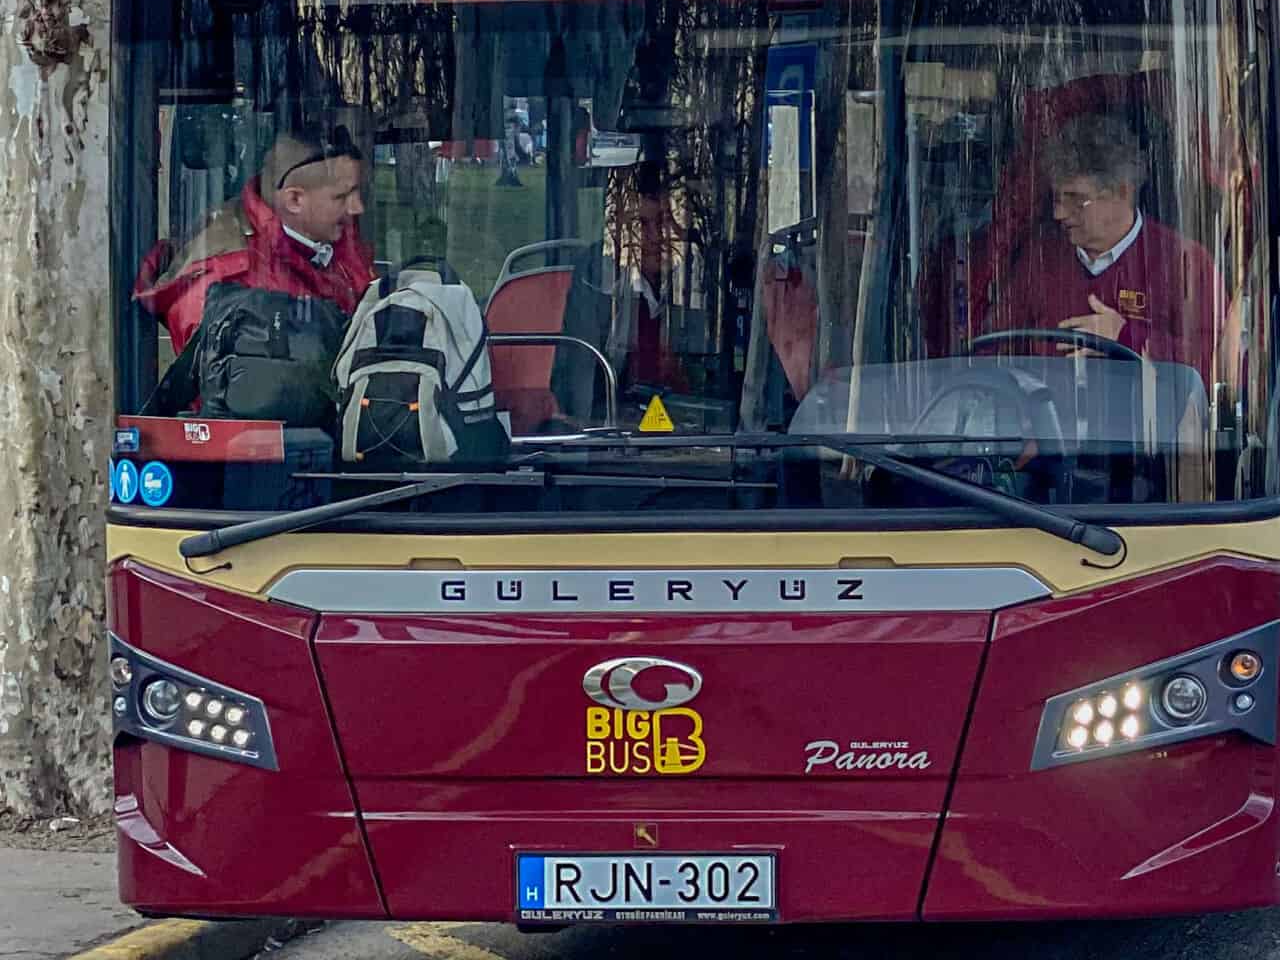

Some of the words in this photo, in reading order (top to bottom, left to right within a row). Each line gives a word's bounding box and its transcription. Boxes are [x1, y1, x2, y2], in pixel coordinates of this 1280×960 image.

[440, 580, 864, 602] GÜLERYÜZ
[586, 706, 651, 740] BIG
[586, 741, 652, 774] BUS
[804, 740, 932, 774] Panora
[526, 886, 539, 902] H
[554, 861, 761, 904] RJN-302
